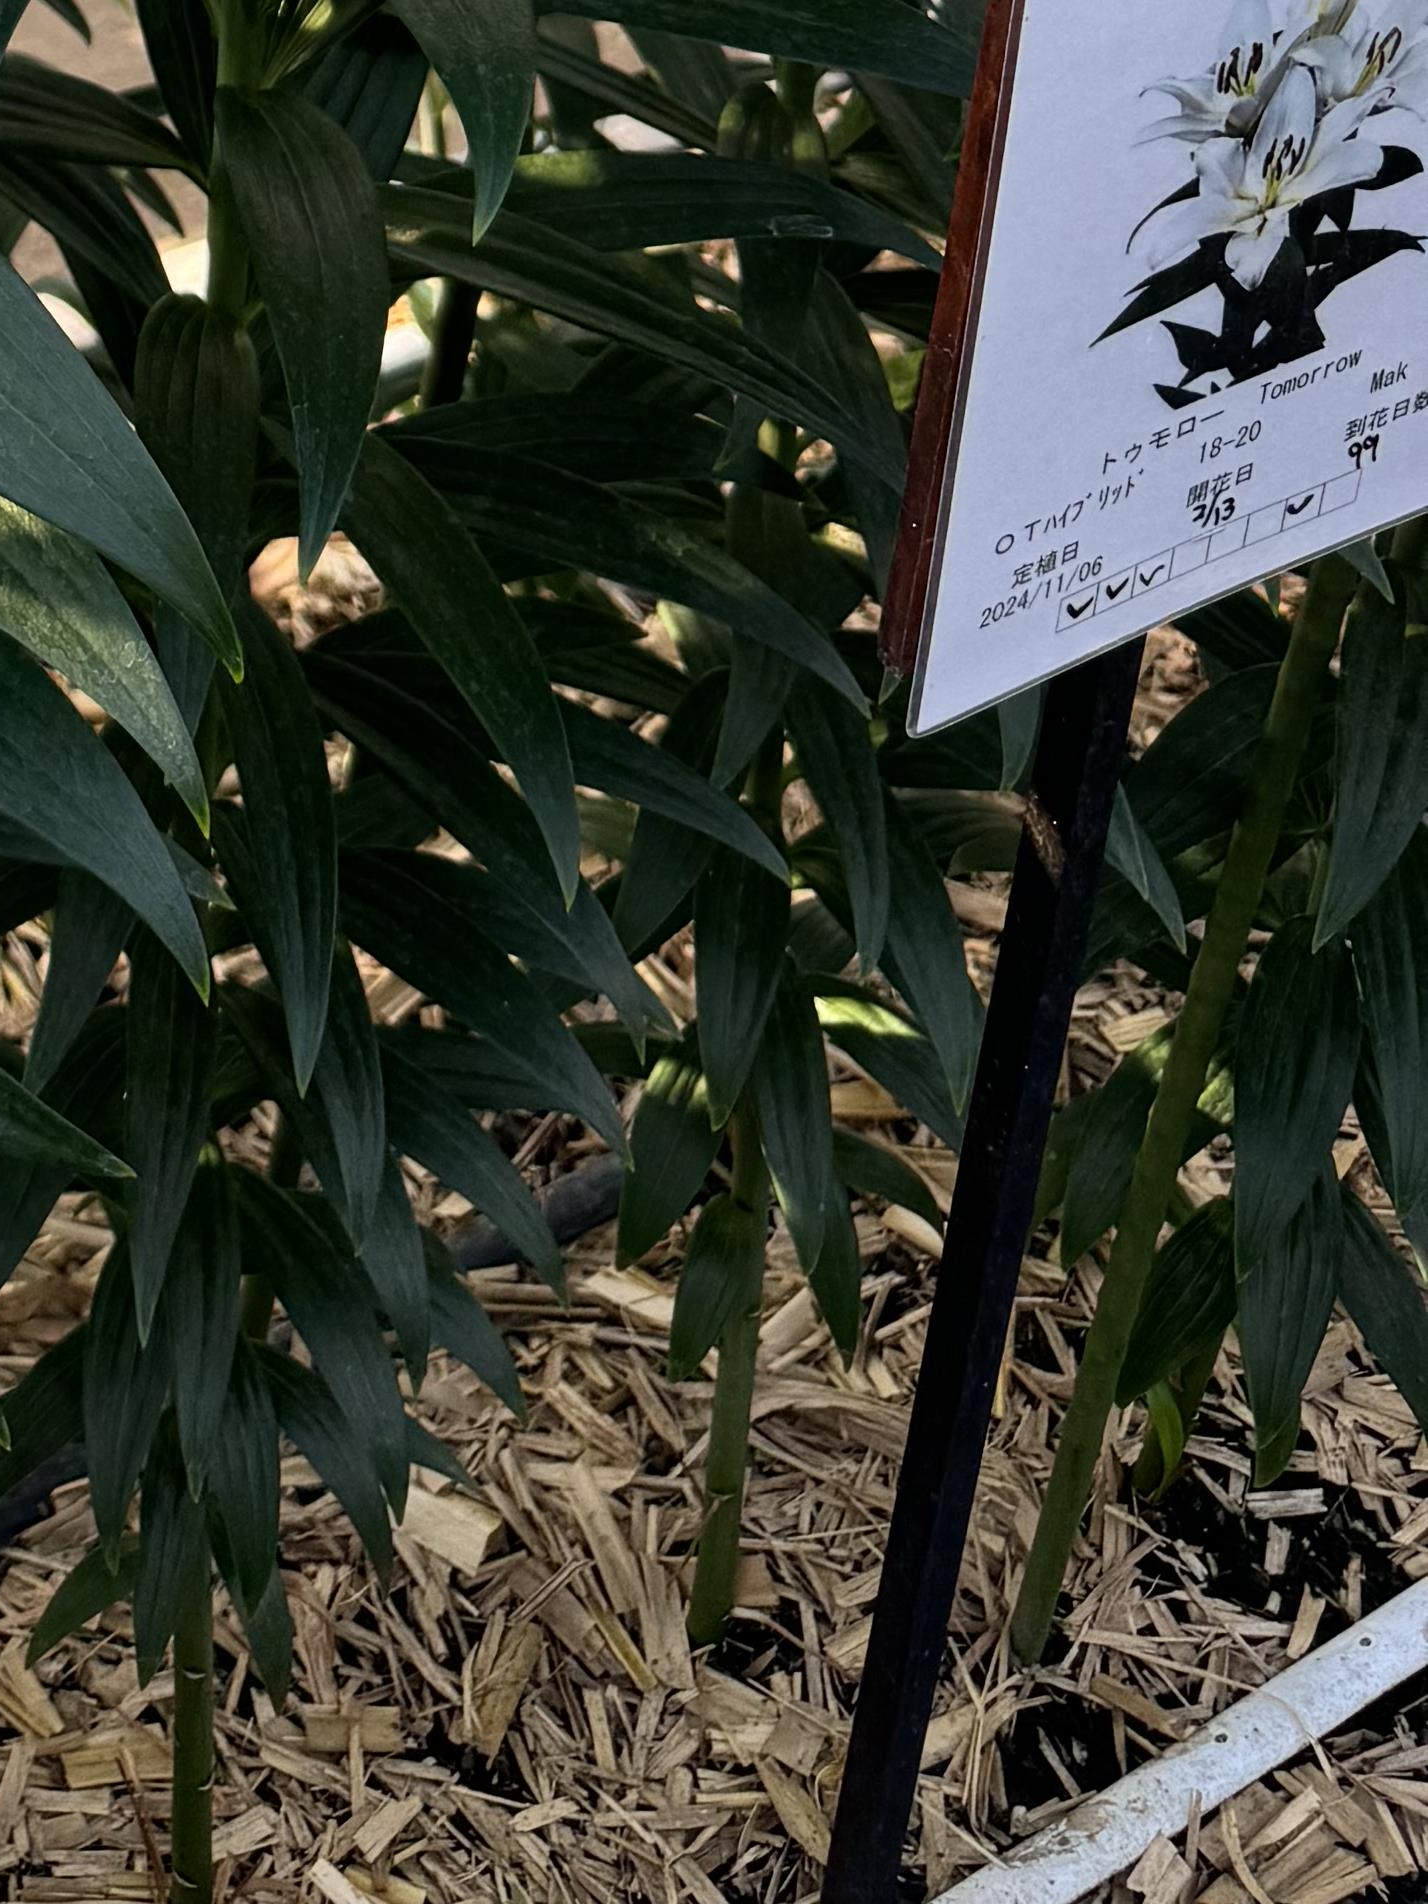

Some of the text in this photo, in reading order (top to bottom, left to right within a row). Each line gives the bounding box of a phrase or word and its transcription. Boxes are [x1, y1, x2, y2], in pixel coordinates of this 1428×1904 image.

[1259, 349, 1363, 405] Tomorrow
[1200, 419, 1262, 464] 18-20
[1370, 361, 1408, 394] Mak
[1348, 433, 1380, 470] 99
[1011, 541, 1079, 589] 定植日
[1186, 462, 1254, 508] 開花日
[1192, 490, 1236, 528] 2/13
[979, 555, 1104, 629] 2024/11/06
